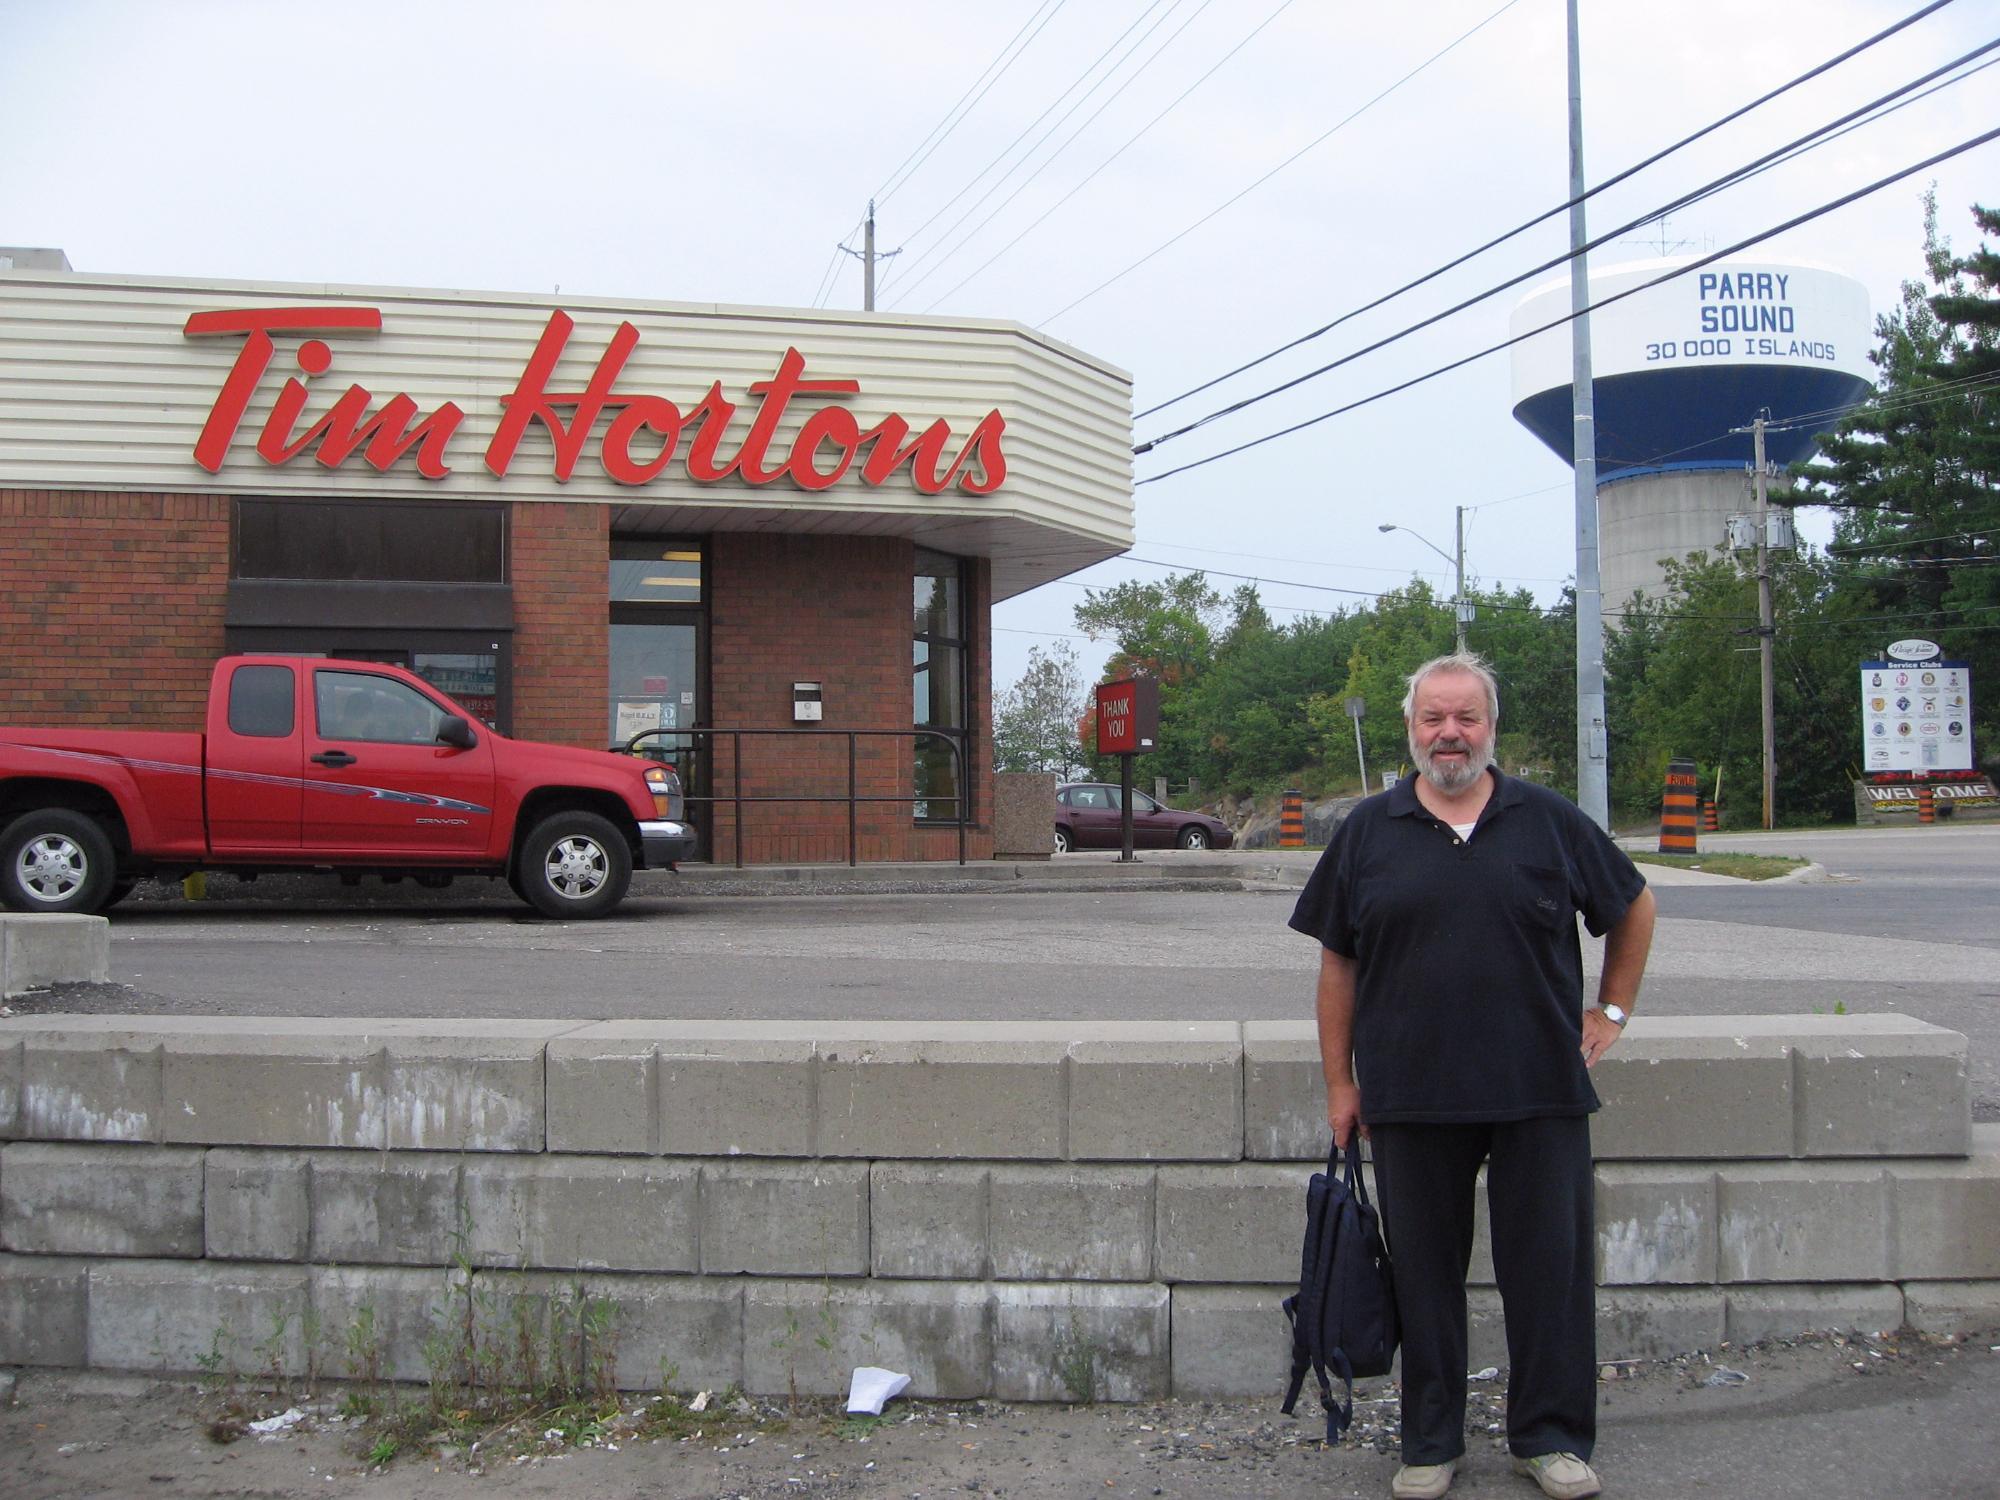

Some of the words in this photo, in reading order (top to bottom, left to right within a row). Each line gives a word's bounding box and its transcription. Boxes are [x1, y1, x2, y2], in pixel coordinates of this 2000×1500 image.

[1700, 273, 1789, 300] PARRY
[1701, 305, 1794, 333] SOUND
[1745, 338, 1836, 361] ISLANDS
[183, 306, 465, 480] Tim
[484, 307, 1007, 497] Hortons
[1102, 698, 1129, 718] THANK
[1108, 720, 1125, 737] YOU
[415, 817, 469, 825] CANYON
